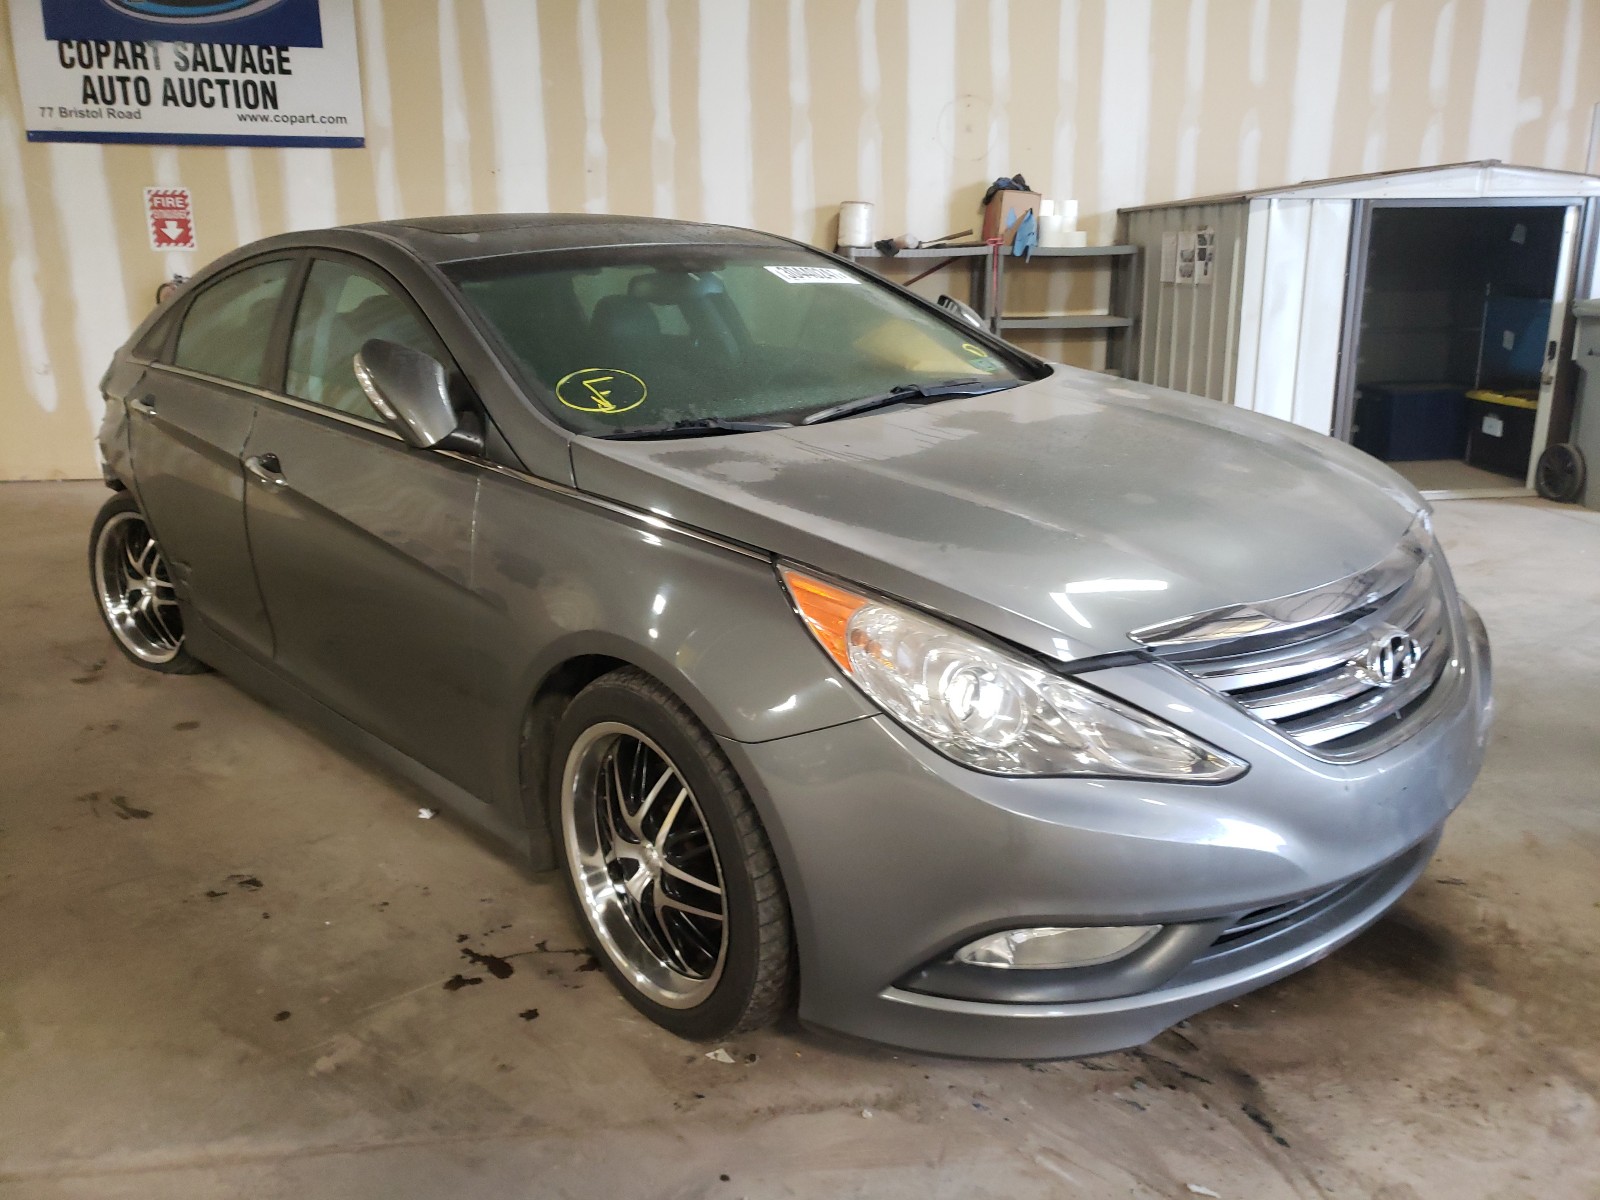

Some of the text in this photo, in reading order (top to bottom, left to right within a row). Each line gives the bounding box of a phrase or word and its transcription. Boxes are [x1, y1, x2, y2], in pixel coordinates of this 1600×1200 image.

[58, 40, 292, 75] COPART SALVAGE
[82, 75, 279, 110] AUTO AUCTION
[39, 106, 142, 119] 77 Bristol Road
[237, 113, 348, 125] www.copart.com
[153, 197, 185, 208] FIRE
